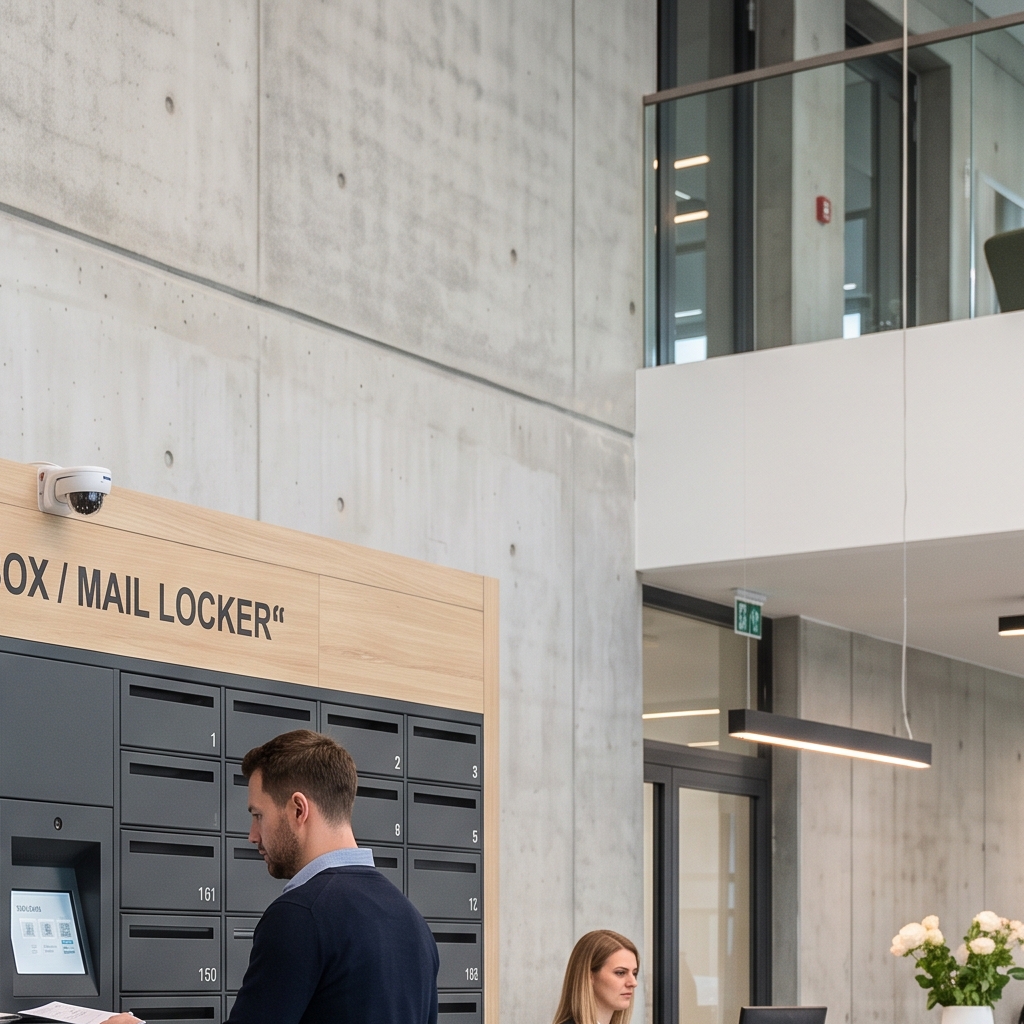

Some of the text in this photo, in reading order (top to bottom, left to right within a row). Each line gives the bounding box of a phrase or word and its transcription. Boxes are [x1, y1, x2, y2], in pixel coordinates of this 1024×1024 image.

[57, 562, 69, 604] /
[78, 565, 150, 619] MAIL
[210, 732, 216, 748] 1
[394, 755, 401, 770] 2
[471, 764, 478, 779] 3
[472, 829, 479, 844] 5
[198, 886, 215, 902] 161
[198, 967, 217, 983] 150
